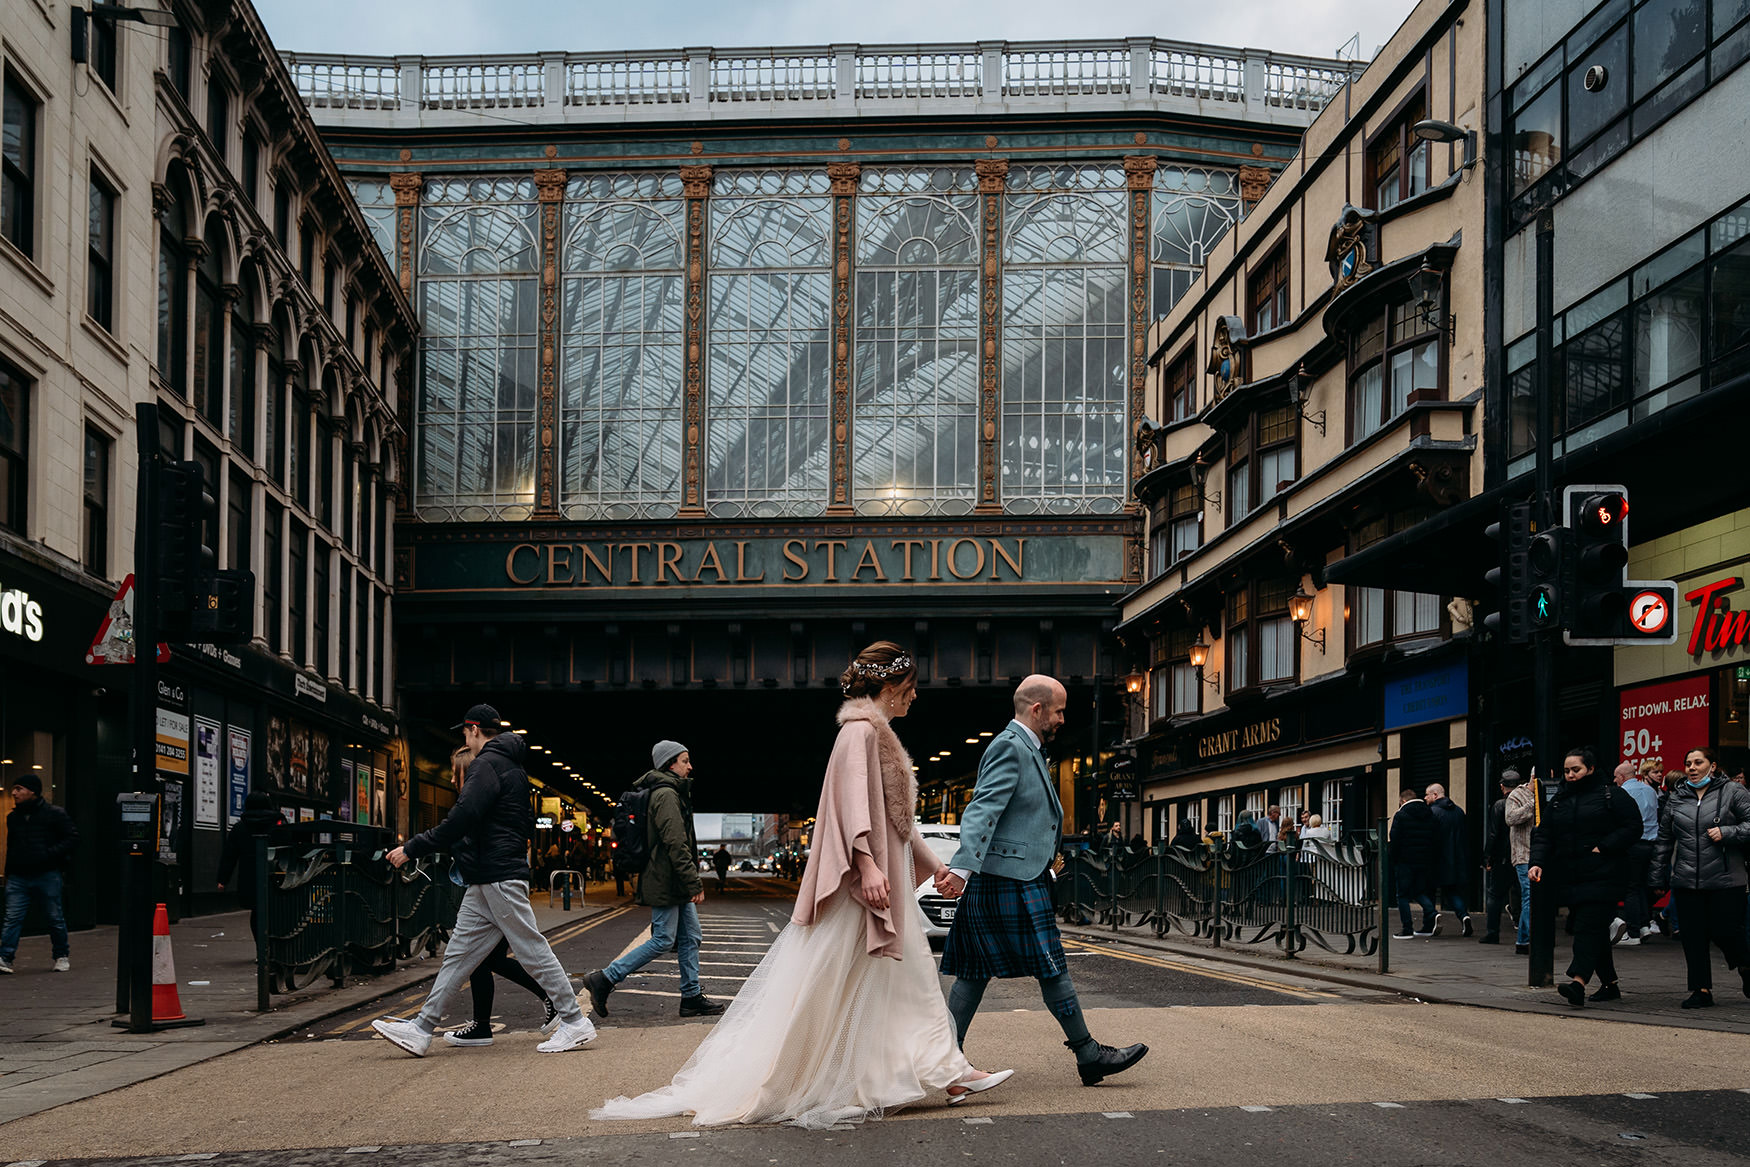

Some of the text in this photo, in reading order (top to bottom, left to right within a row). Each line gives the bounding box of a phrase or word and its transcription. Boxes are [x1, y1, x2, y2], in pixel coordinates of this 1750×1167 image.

[505, 538, 1028, 584] CENTRAL STATION
[0, 588, 43, 642] d's
[1622, 694, 1710, 720] SIT DOWN. RELAX.
[1198, 729, 1238, 758] GRANT
[1241, 717, 1281, 749] ARMS
[1623, 728, 1663, 757] 50+
